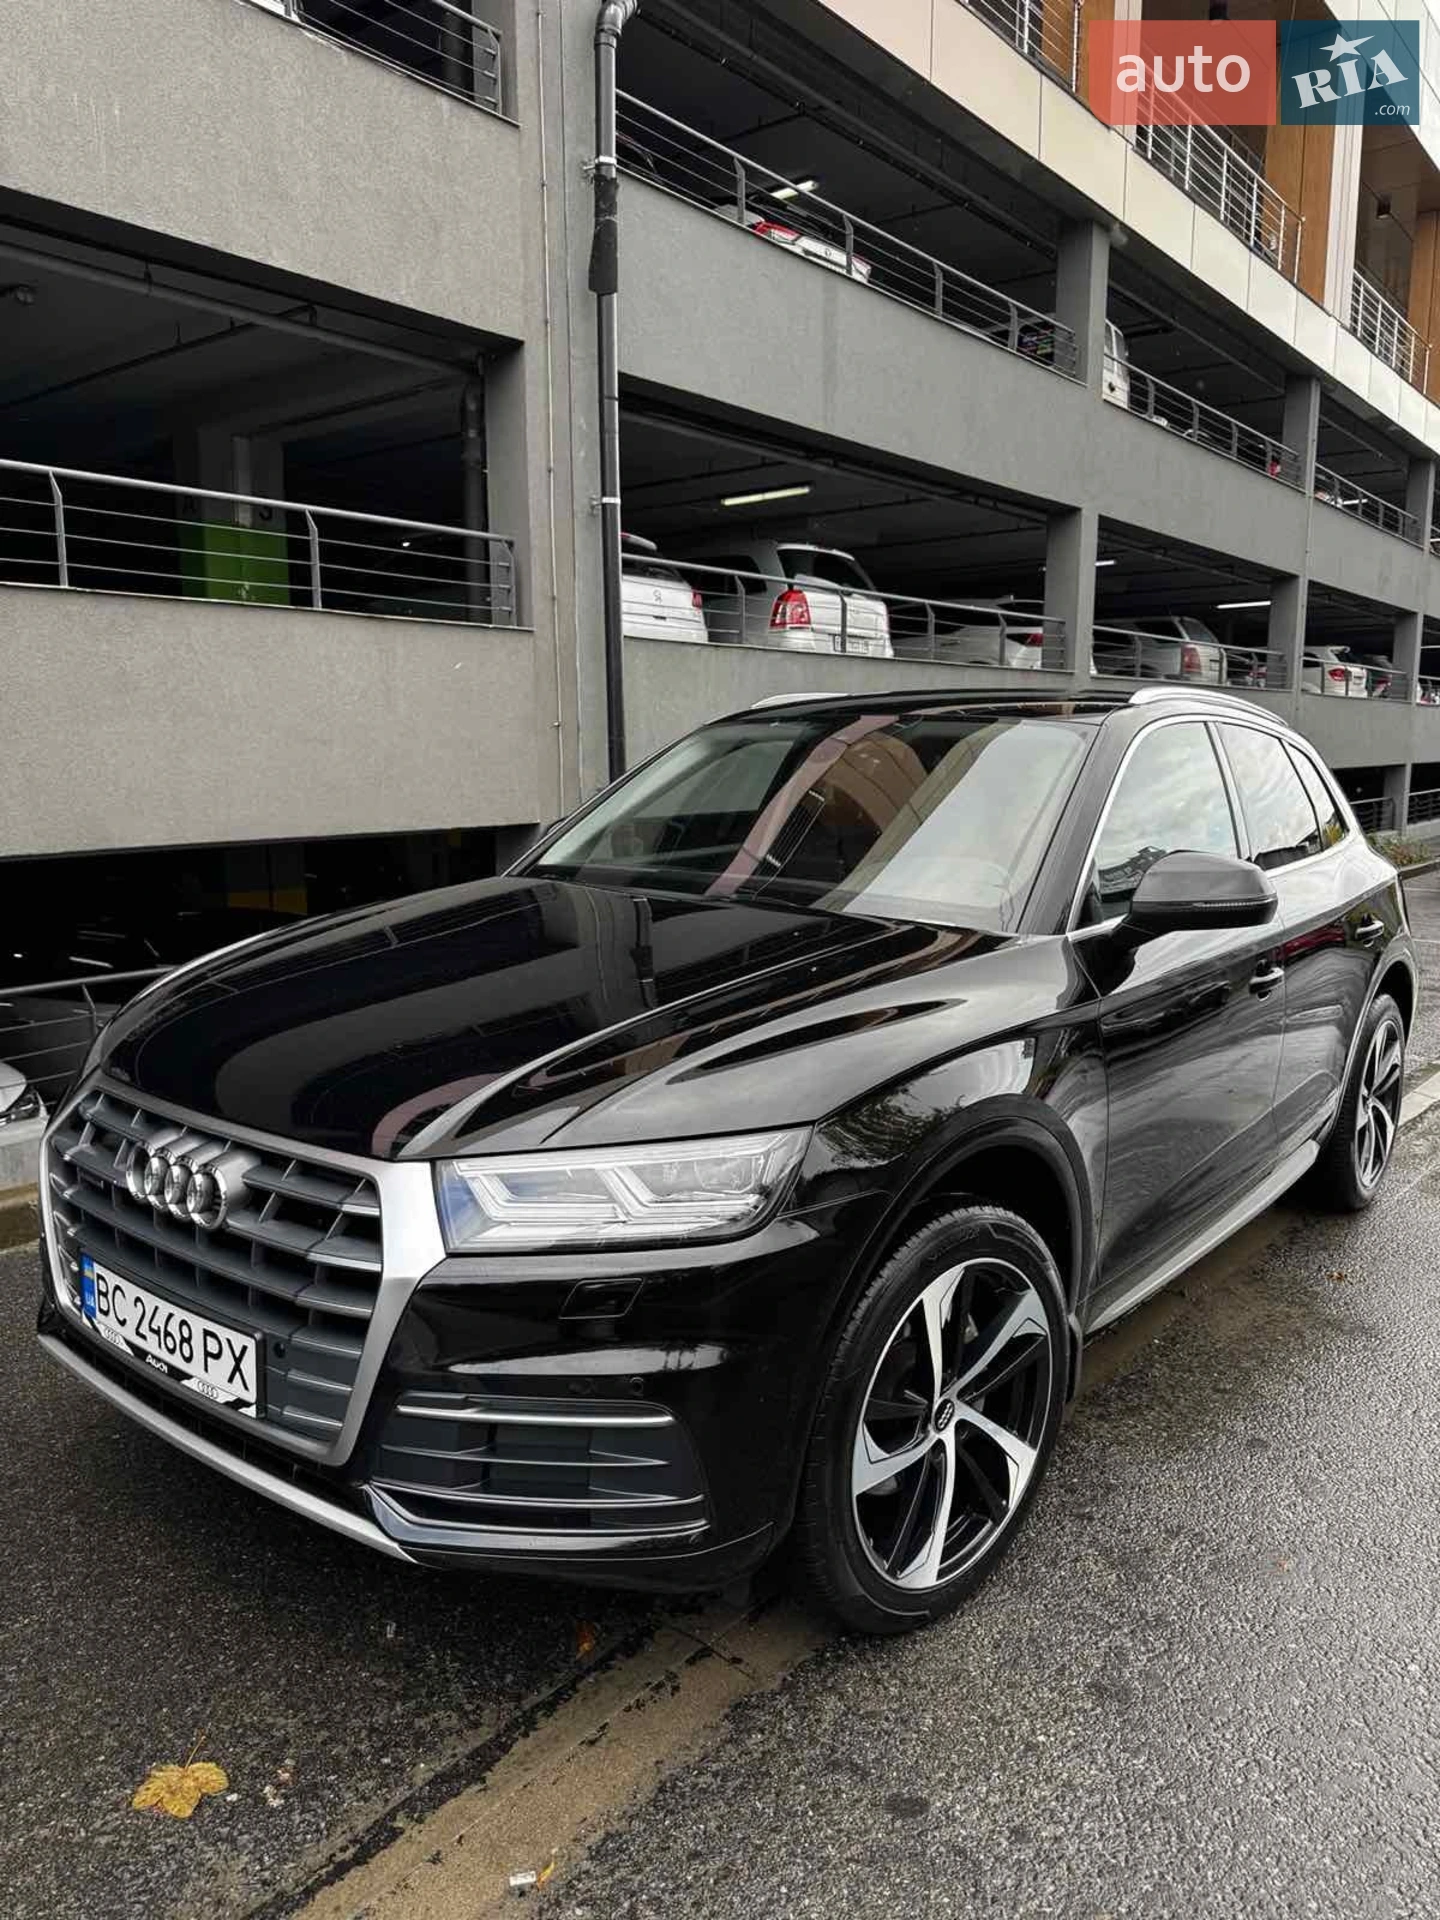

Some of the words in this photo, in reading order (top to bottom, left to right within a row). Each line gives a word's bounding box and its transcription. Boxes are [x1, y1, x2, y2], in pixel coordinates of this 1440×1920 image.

[96, 1272, 127, 1327] BC
[134, 1296, 193, 1364] 2468
[203, 1328, 250, 1391] PX
